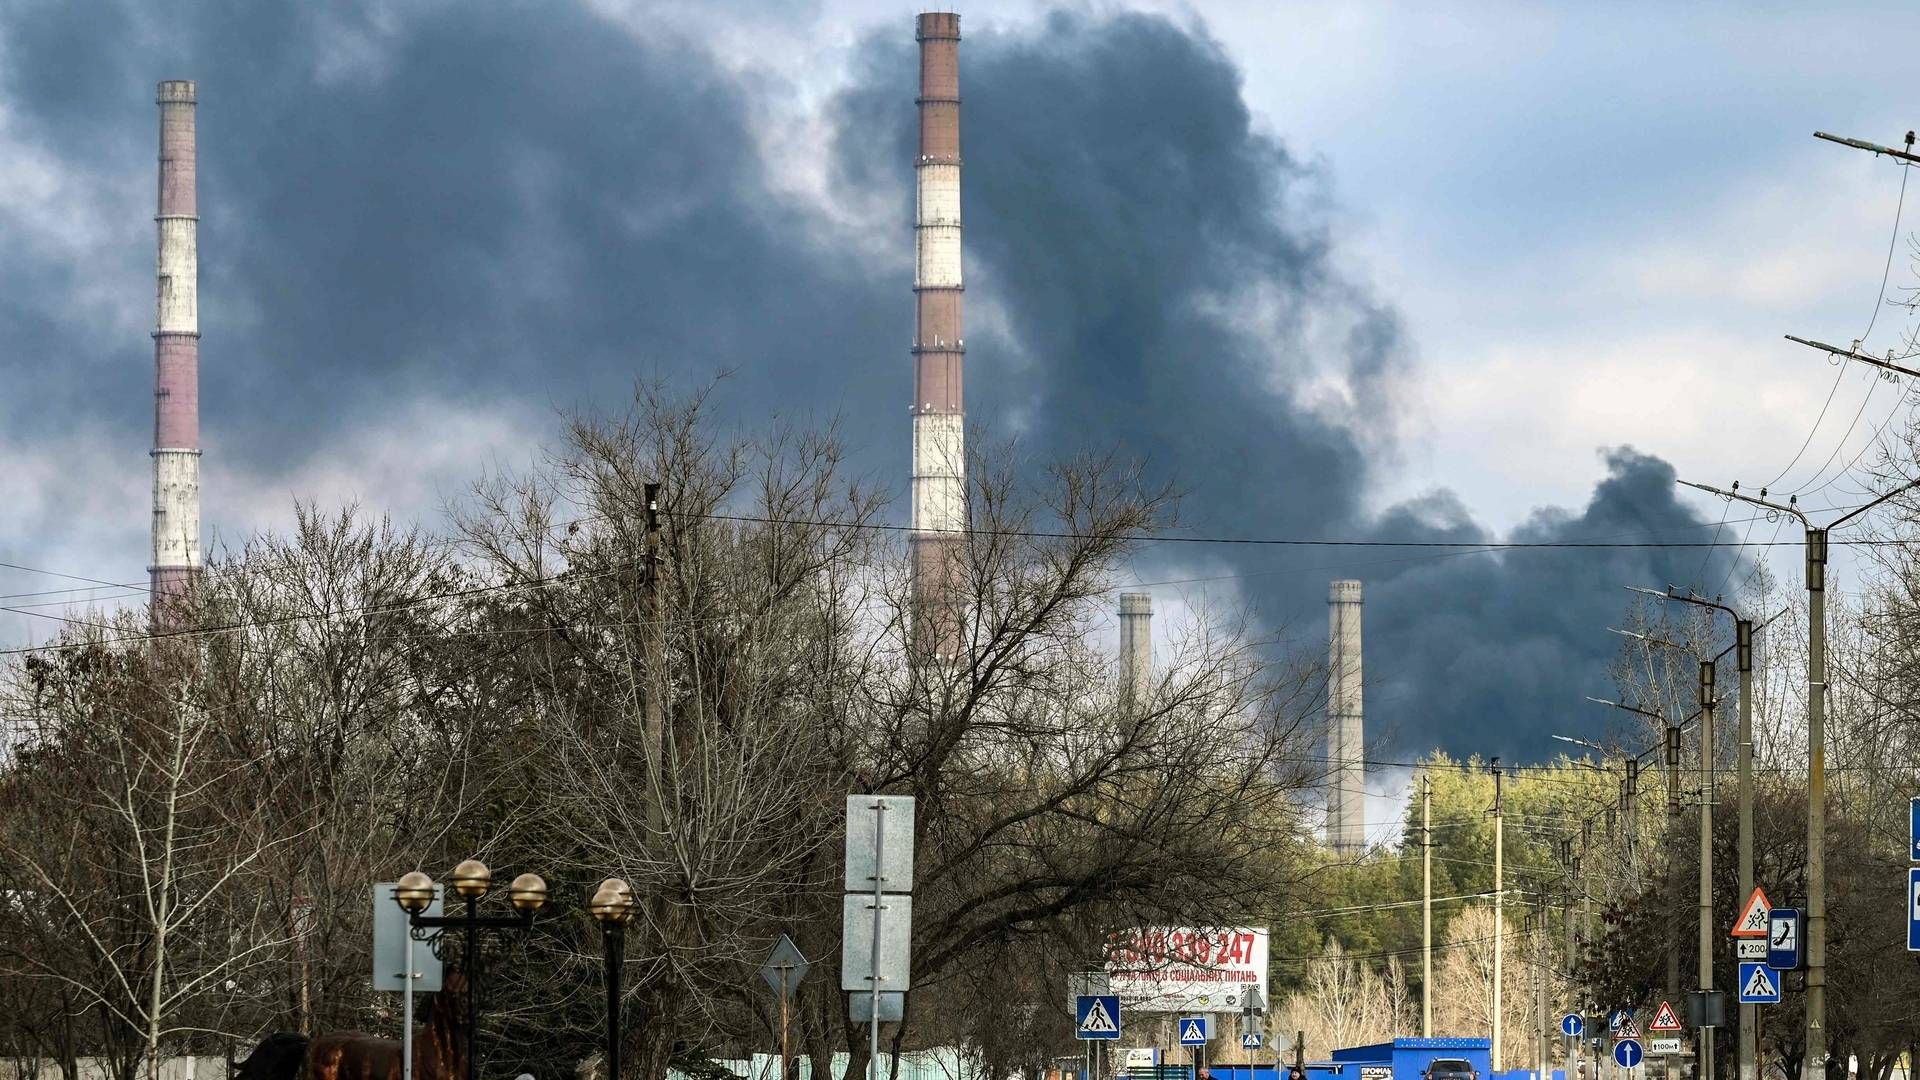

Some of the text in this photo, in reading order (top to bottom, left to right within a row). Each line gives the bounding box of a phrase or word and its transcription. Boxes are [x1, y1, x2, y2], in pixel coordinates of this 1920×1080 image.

[1216, 932, 1255, 965] 247
[1169, 969, 1222, 984] СОЦІАЛЬНИХ
[1225, 970, 1257, 982] ПИТАНЬ
